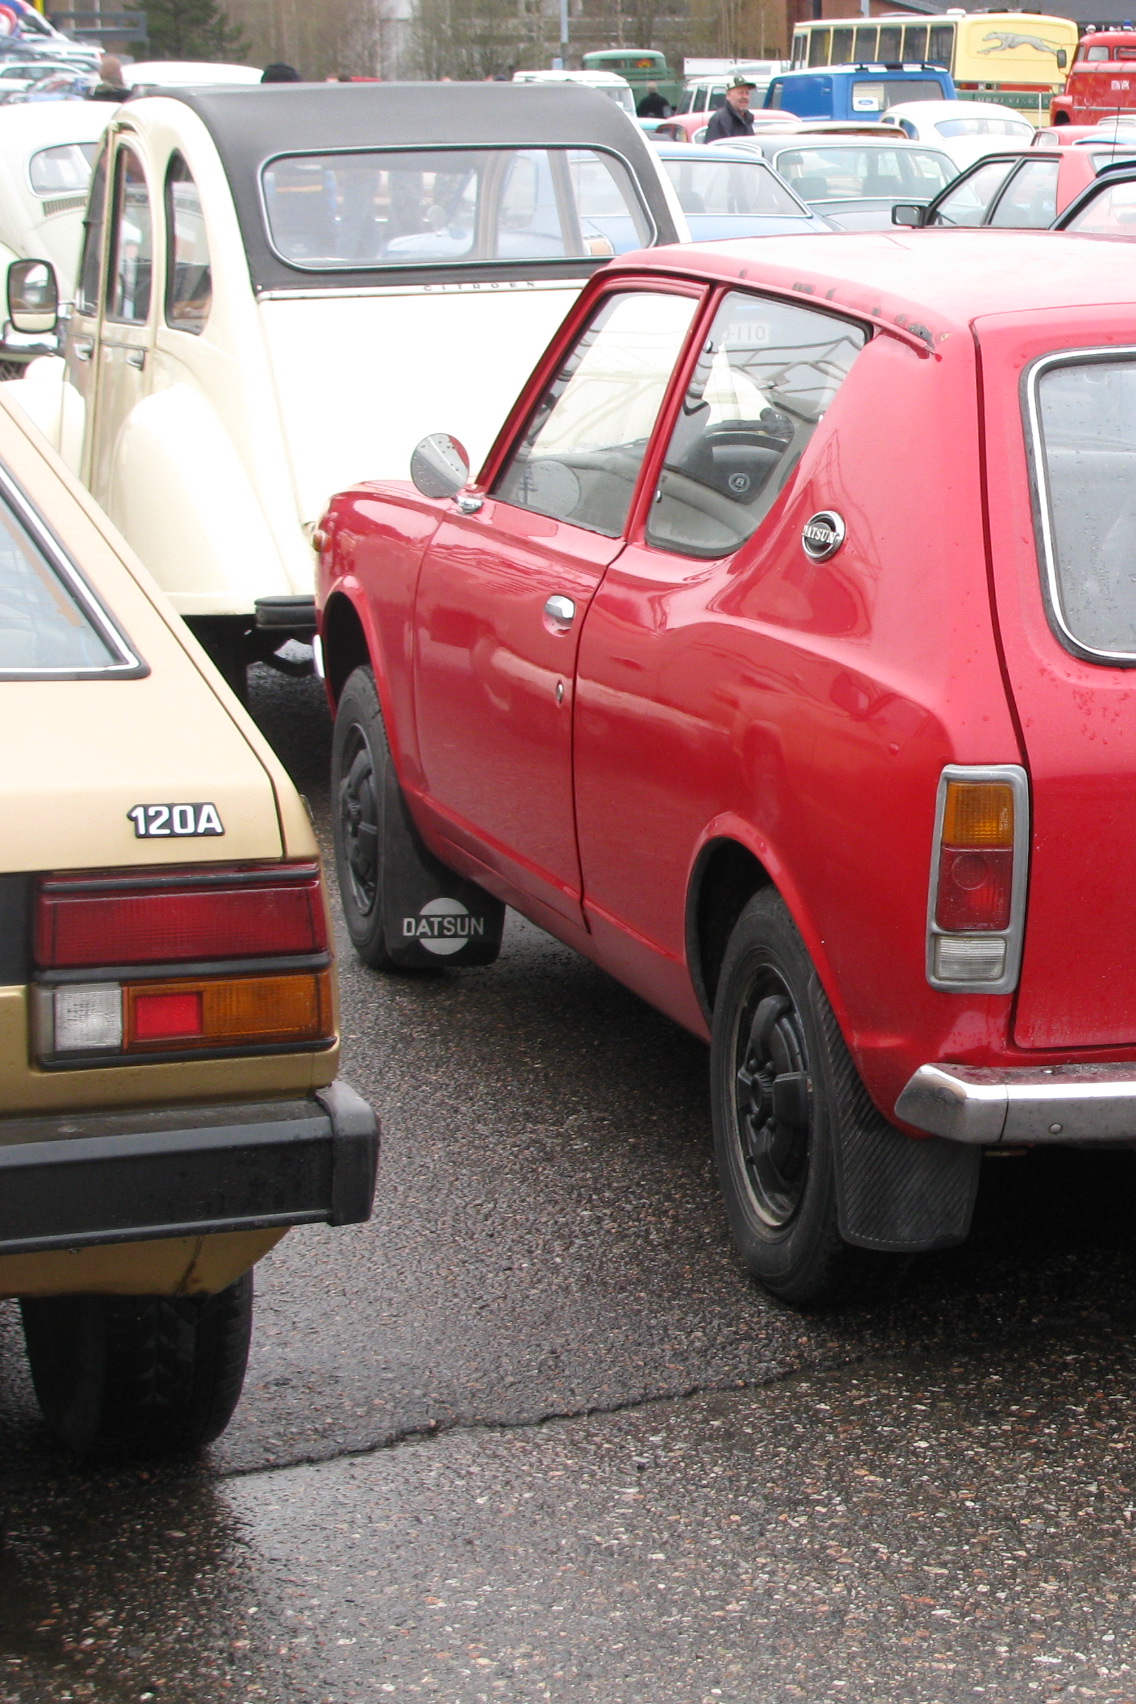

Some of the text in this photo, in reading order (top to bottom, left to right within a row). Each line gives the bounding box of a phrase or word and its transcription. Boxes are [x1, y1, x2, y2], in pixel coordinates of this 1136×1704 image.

[802, 525, 838, 544] DATSUN
[131, 804, 223, 835] 120A
[403, 917, 484, 936] DATSUN
